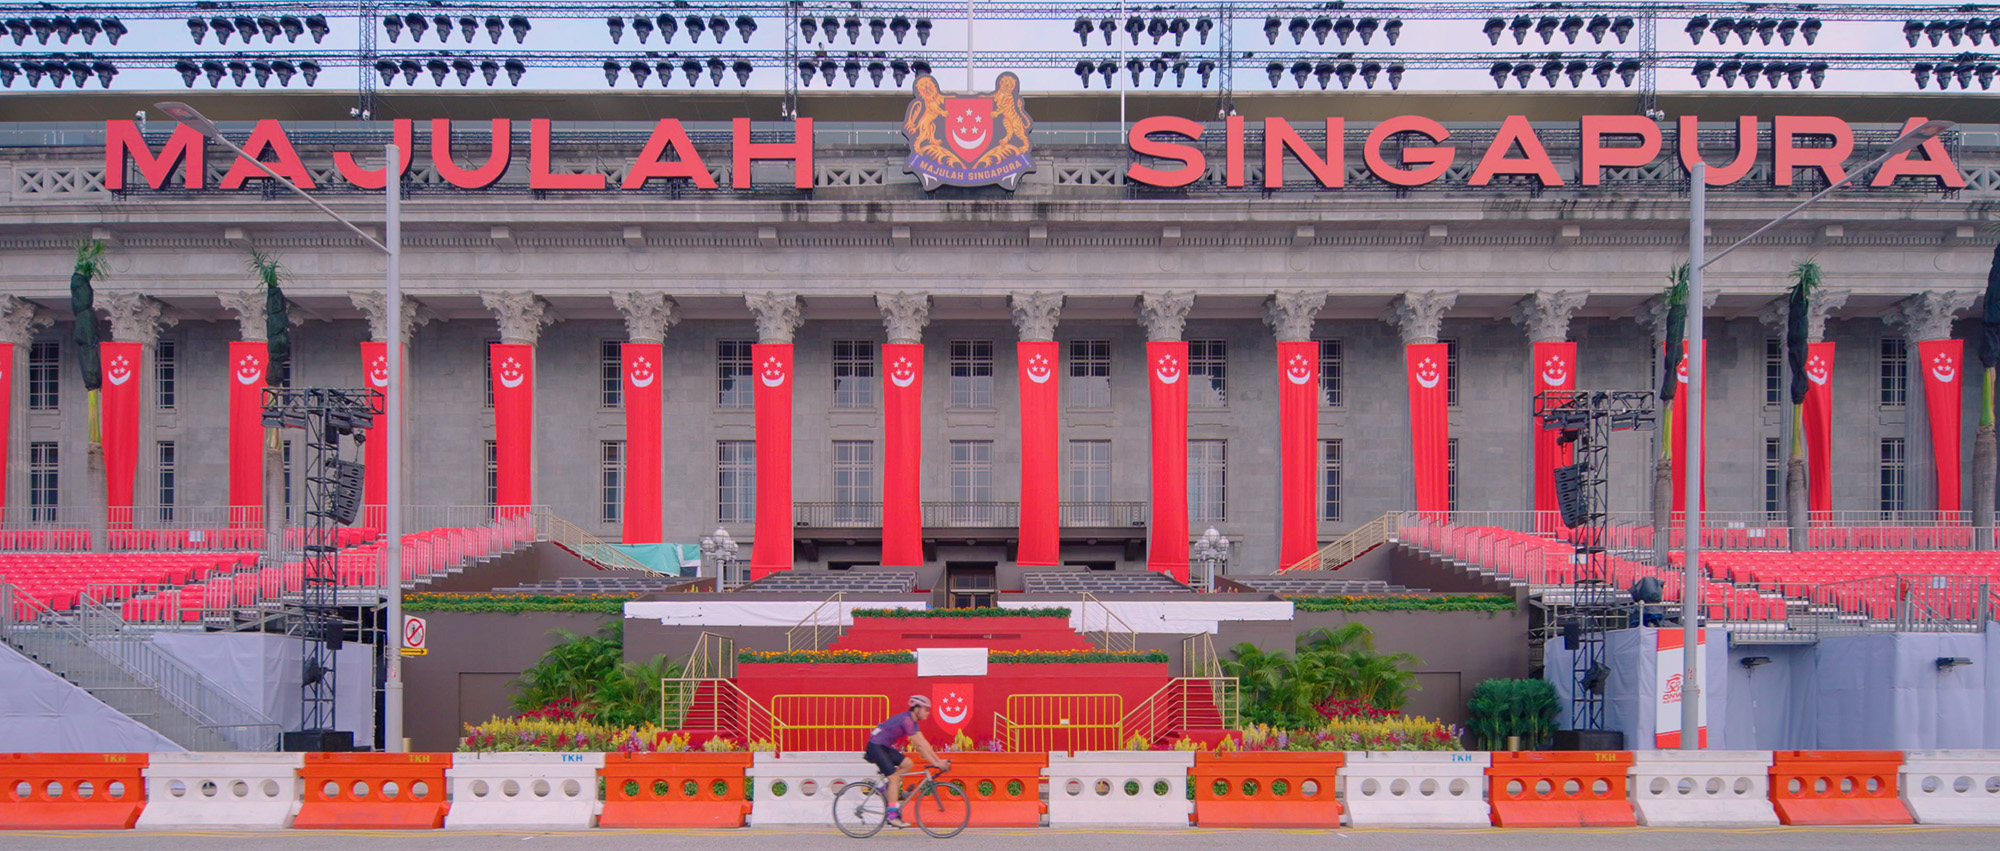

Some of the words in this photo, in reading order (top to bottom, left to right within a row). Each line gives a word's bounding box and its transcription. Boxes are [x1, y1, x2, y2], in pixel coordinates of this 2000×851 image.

[105, 117, 813, 189] MAJULAH
[1127, 115, 1967, 187] SINGAPURA
[920, 160, 964, 180] MAJULAH
[968, 160, 1022, 181] SINGAPURA
[104, 754, 127, 763] TKH
[408, 754, 430, 763] TKH
[561, 754, 583, 762] TKH
[1452, 753, 1472, 761] TKH
[1595, 753, 1617, 761] TKH
